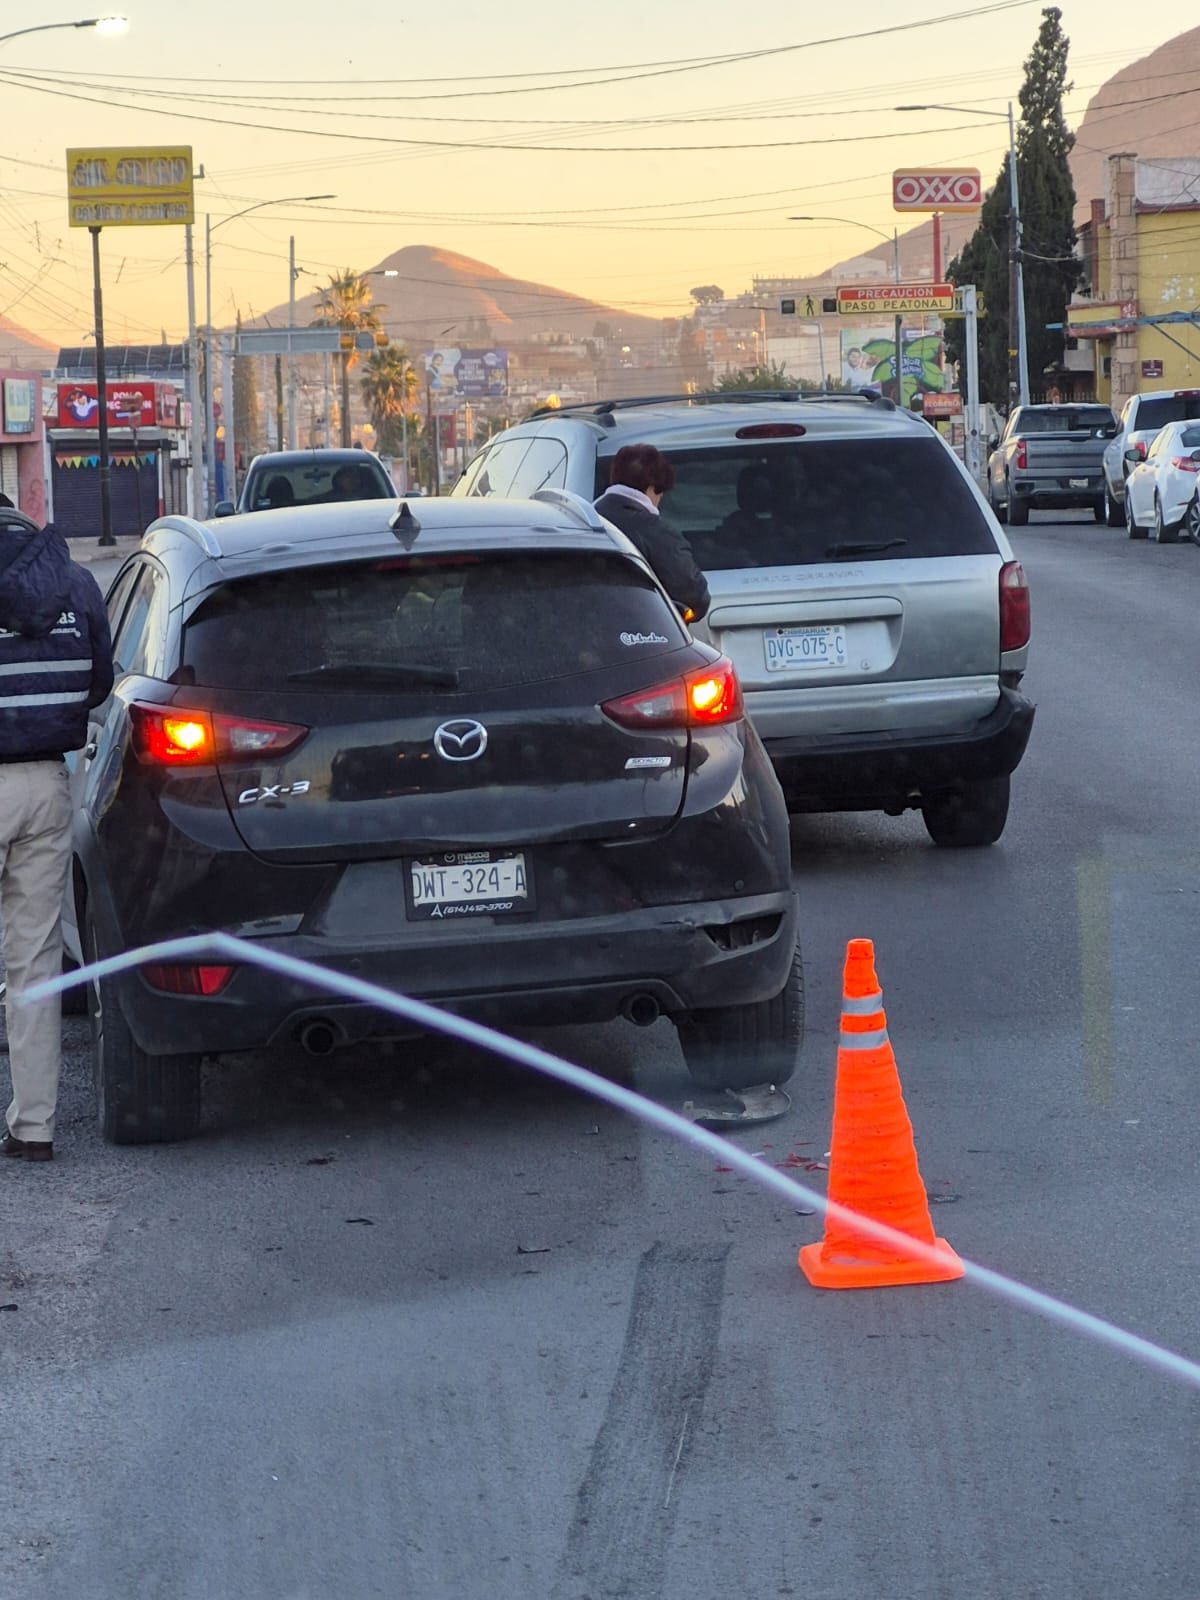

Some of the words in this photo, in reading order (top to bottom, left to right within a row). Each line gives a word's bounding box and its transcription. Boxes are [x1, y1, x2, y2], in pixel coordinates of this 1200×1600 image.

[896, 176, 977, 205] OXXO
[857, 287, 934, 299] PRECAUCION
[844, 300, 876, 312] PASO
[883, 298, 946, 310] PEATONAL
[796, 568, 865, 582] CARAVAN
[768, 636, 844, 658] DVG-075-C
[238, 780, 311, 804] CX-3
[412, 864, 526, 898] DWT-324-A
